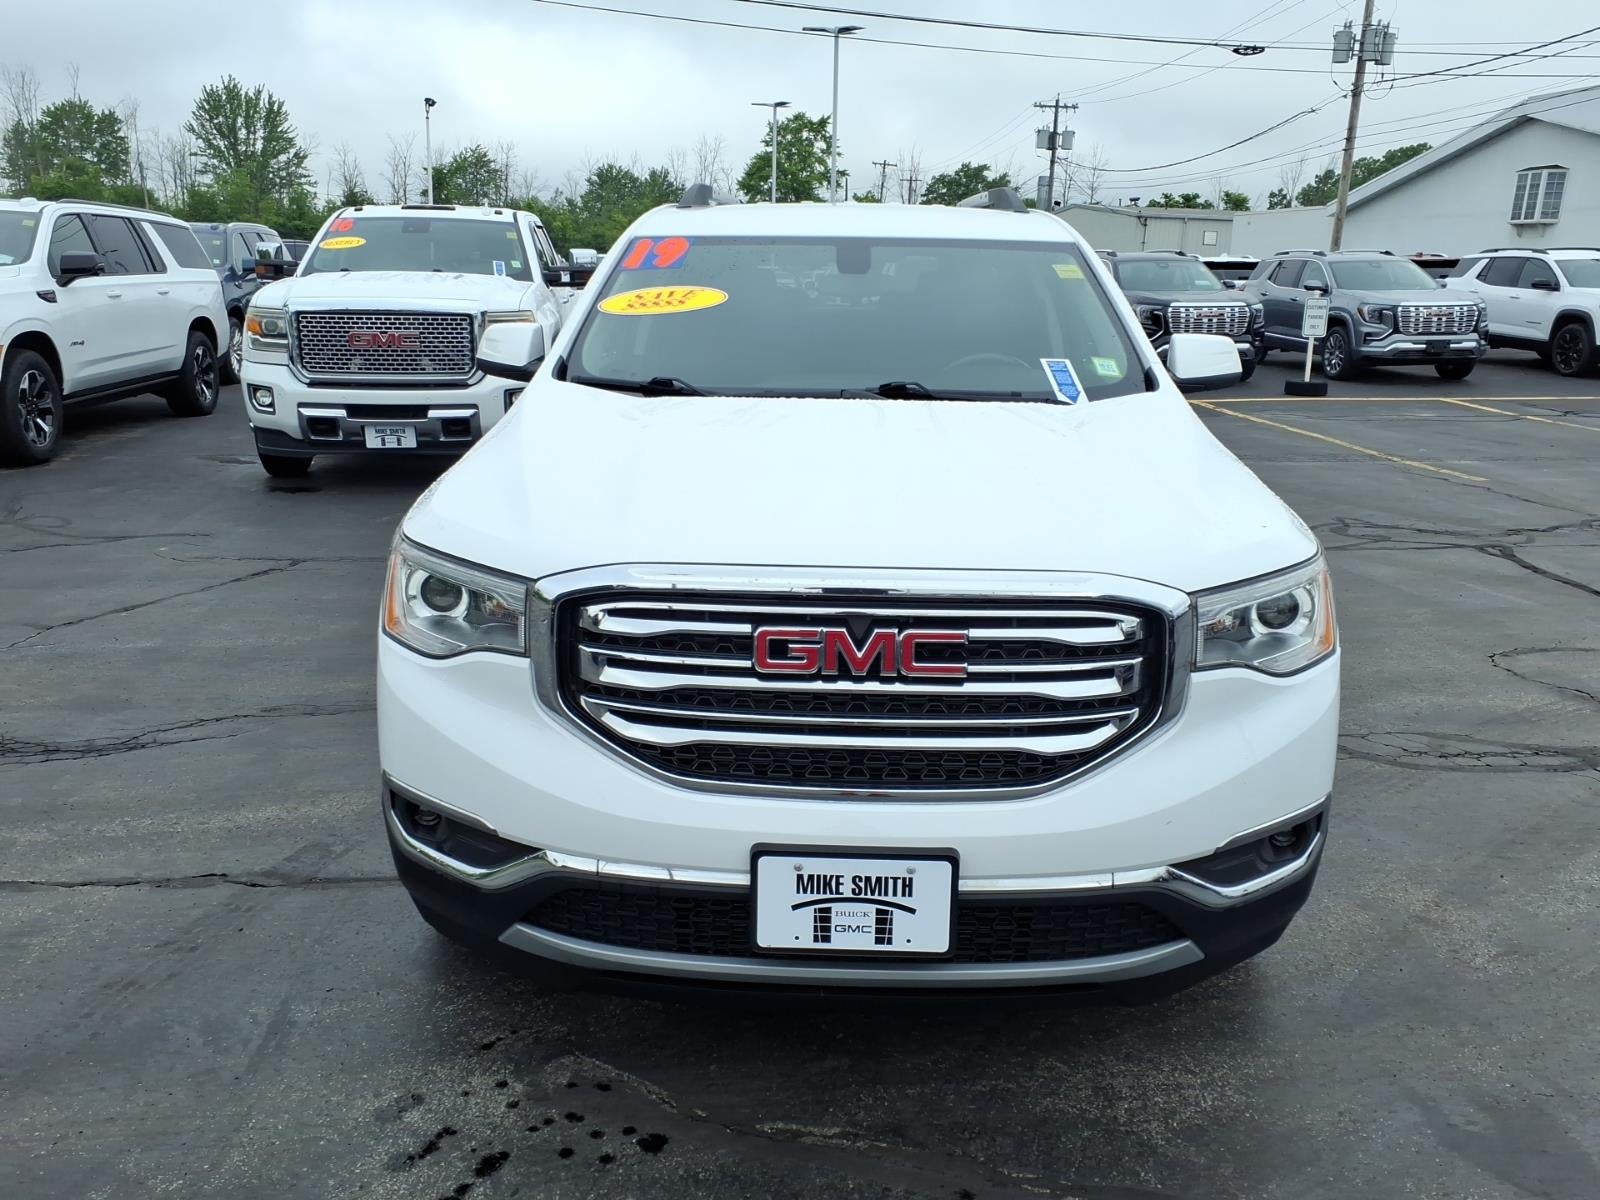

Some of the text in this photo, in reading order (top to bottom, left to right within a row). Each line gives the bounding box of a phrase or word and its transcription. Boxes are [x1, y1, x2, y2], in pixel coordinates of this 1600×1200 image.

[623, 236, 690, 269] 19
[347, 331, 420, 349] GMC
[753, 626, 969, 678] GMC
[796, 873, 914, 898] MIKE SMITH
[834, 910, 871, 918] BUICK
[834, 924, 873, 934] GMC
